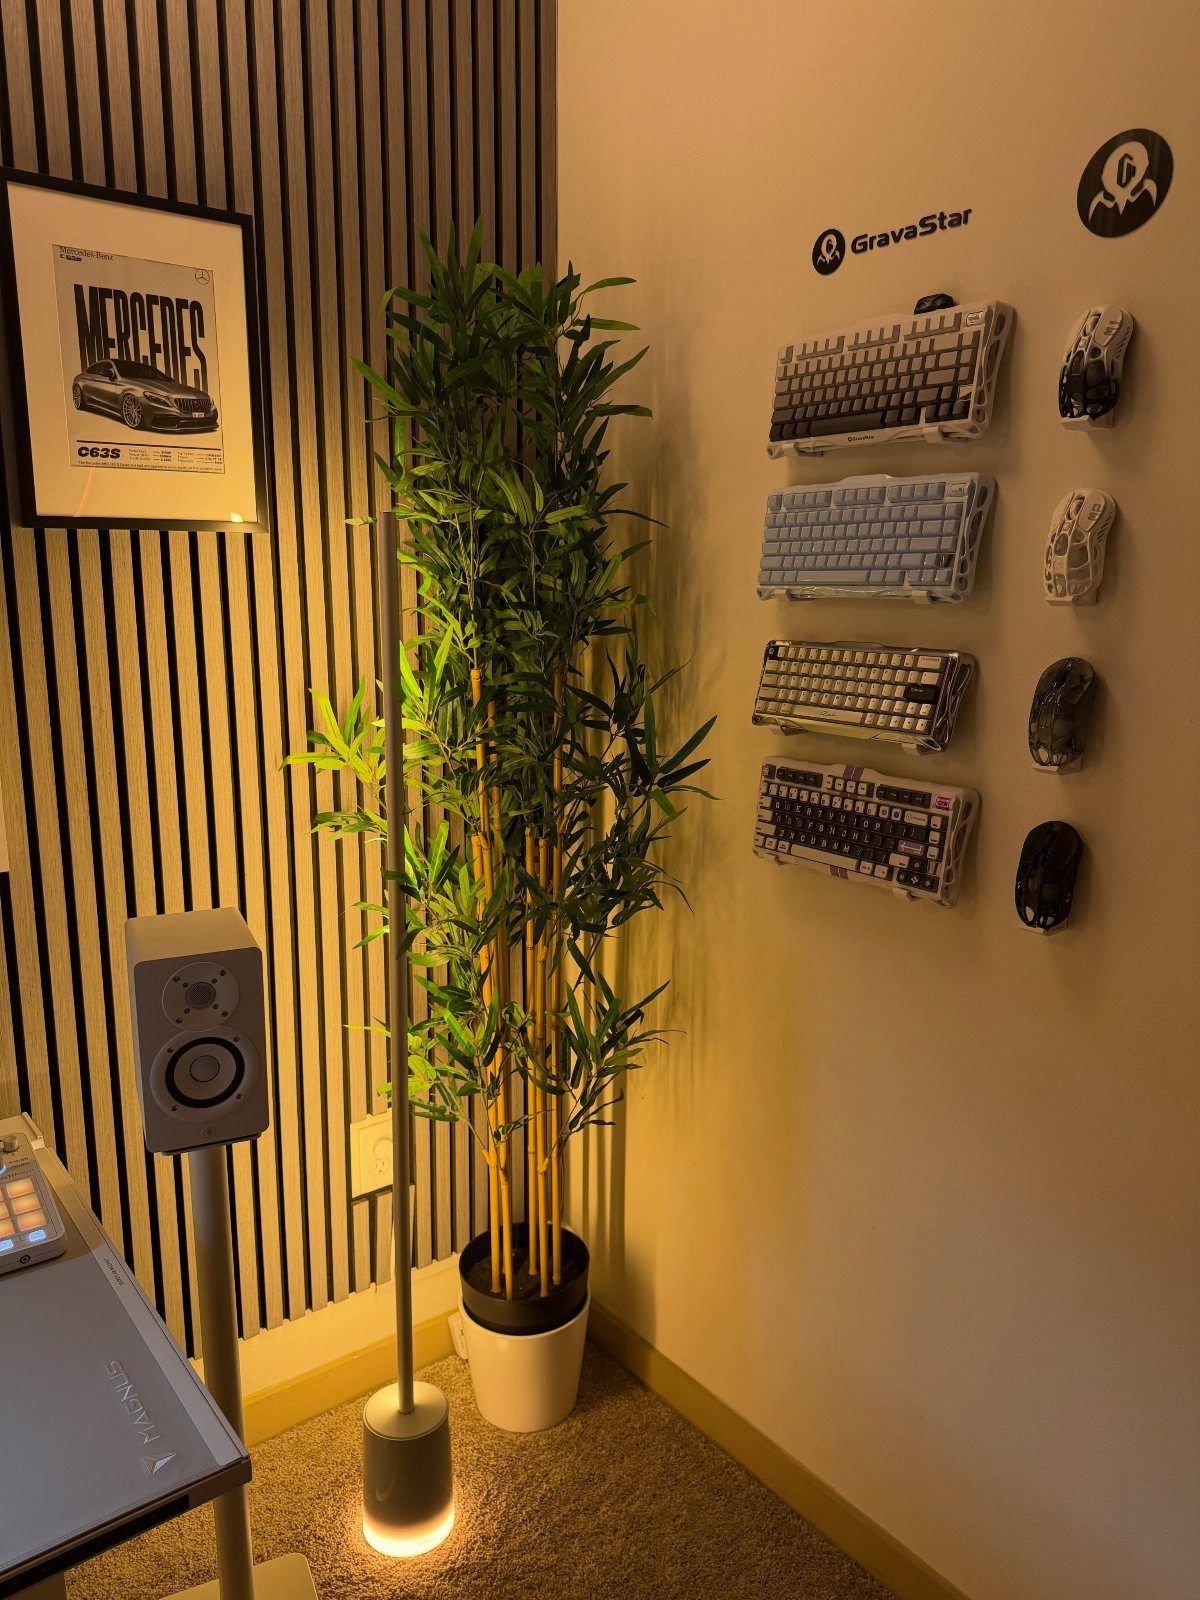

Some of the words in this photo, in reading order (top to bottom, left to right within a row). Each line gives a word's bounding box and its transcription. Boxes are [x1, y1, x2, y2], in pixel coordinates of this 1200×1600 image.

[851, 208, 972, 254] GravaStar
[73, 284, 209, 398] MERCEDES
[77, 446, 121, 459] C63S
[104, 1360, 161, 1445] MAGNUS
